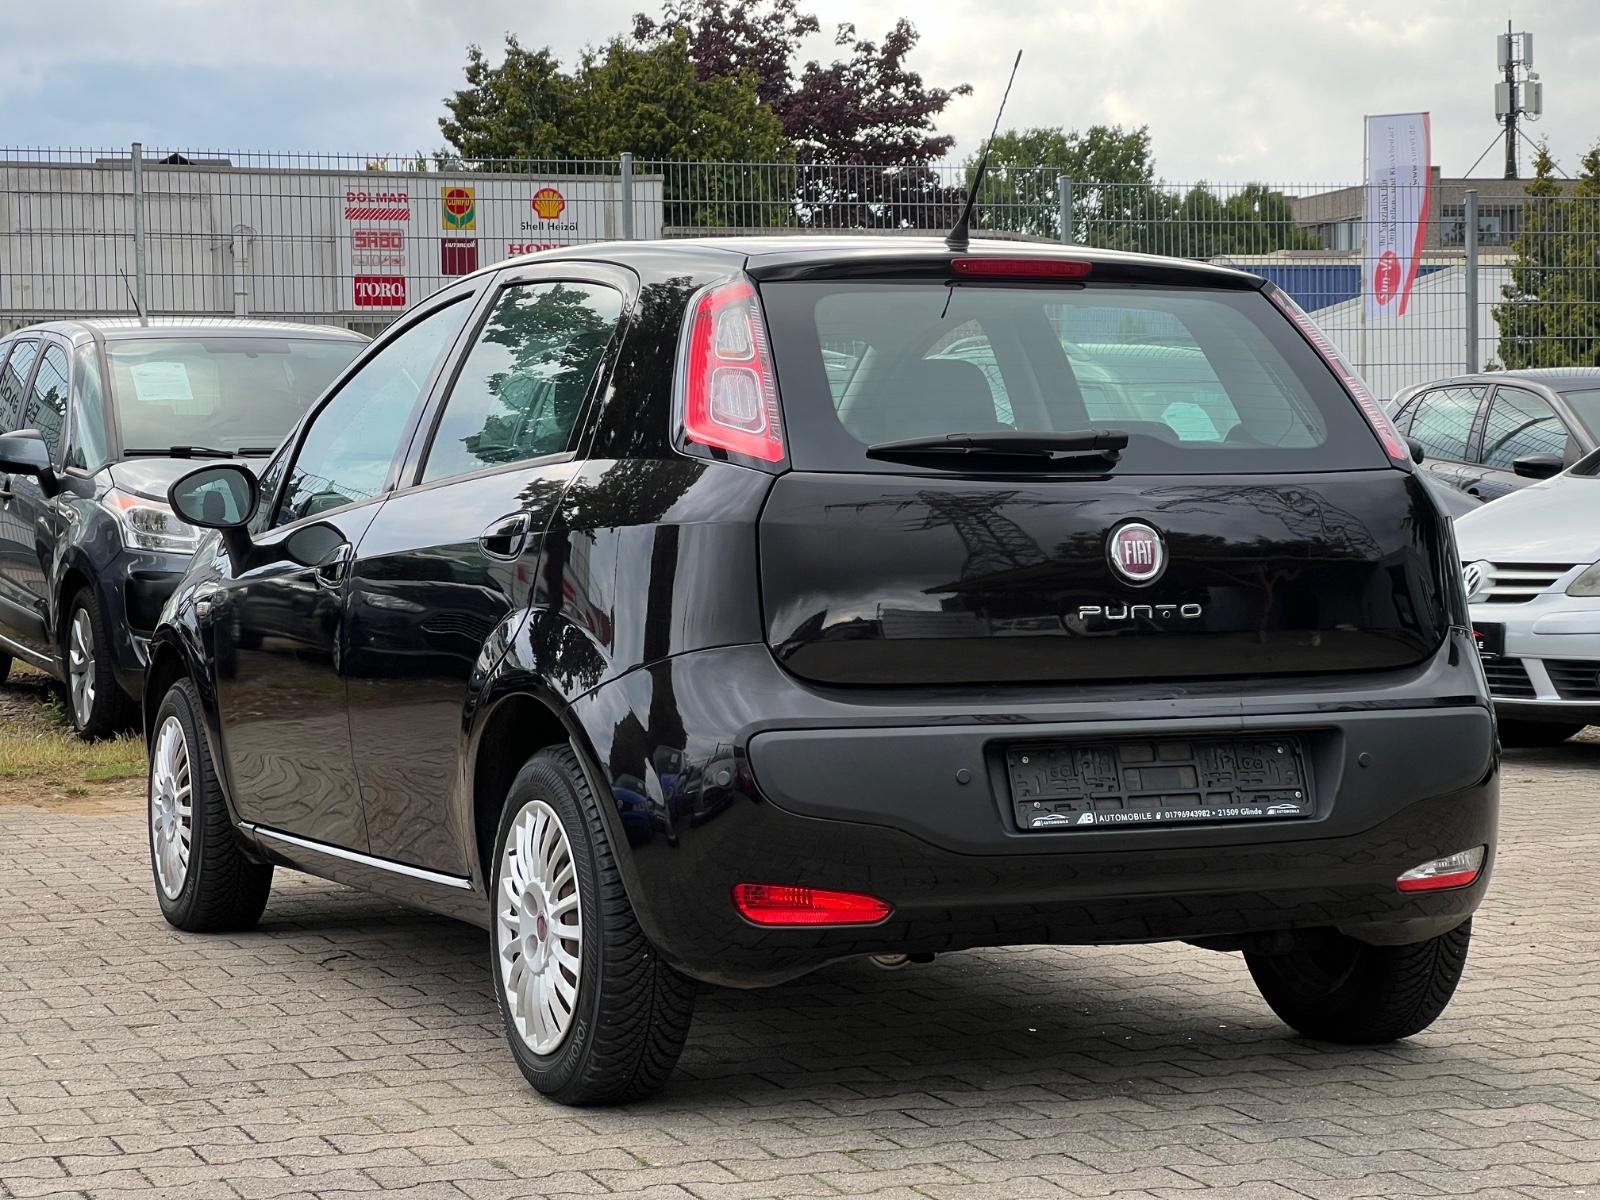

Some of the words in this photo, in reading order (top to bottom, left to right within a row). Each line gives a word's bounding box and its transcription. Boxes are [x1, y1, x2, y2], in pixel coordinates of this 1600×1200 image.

[346, 192, 408, 203] DOLMAR
[1378, 193, 1388, 232] Spezialist
[520, 222, 544, 231] Shell
[547, 221, 578, 231] Heizöl
[355, 231, 402, 248] SABO
[356, 282, 404, 297] TORO
[1124, 540, 1153, 565] FIAT
[1078, 603, 1202, 620] PUNTO
[1099, 812, 1152, 823] AUTOMOBILE
[1218, 807, 1239, 817] 21509
[1240, 807, 1262, 816] Glinde
